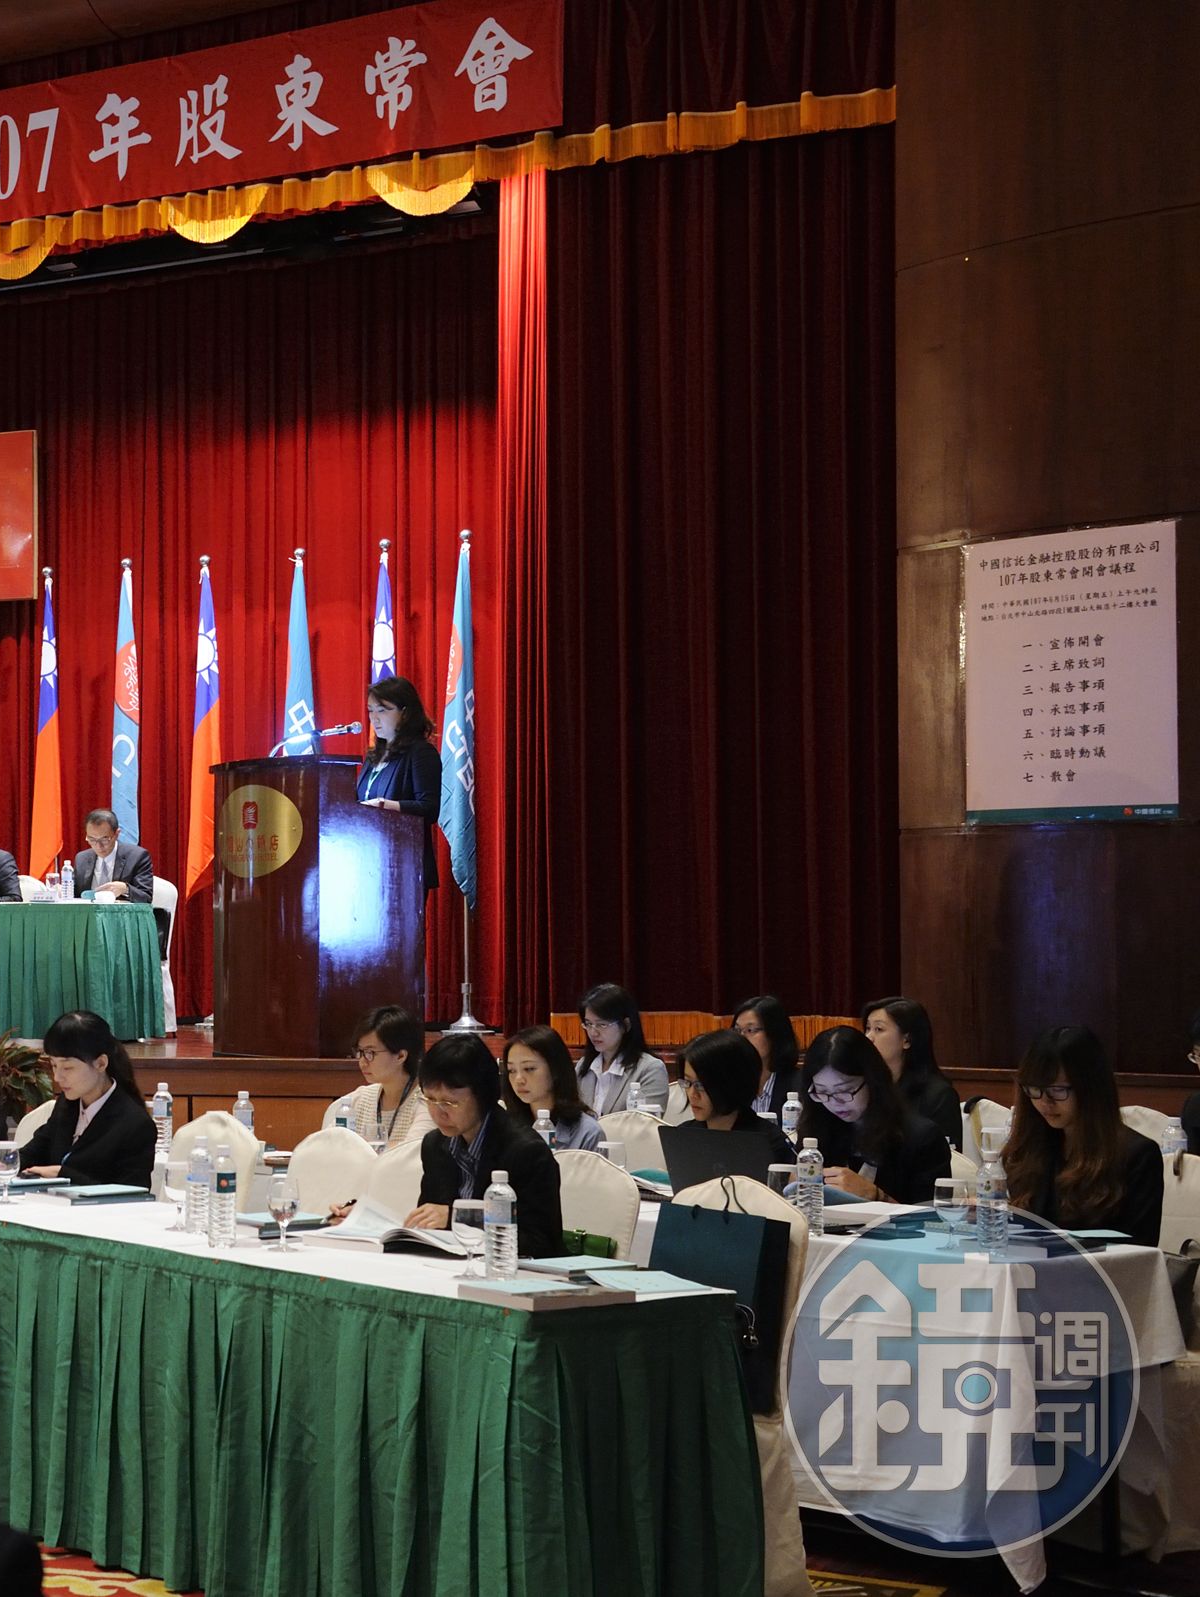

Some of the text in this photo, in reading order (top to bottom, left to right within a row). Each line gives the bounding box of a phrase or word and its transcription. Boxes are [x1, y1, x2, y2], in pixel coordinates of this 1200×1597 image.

[979, 541, 1160, 571] 中國信託金融控股股份有限公司
[999, 562, 1136, 587] 107年股東常會開會議程
